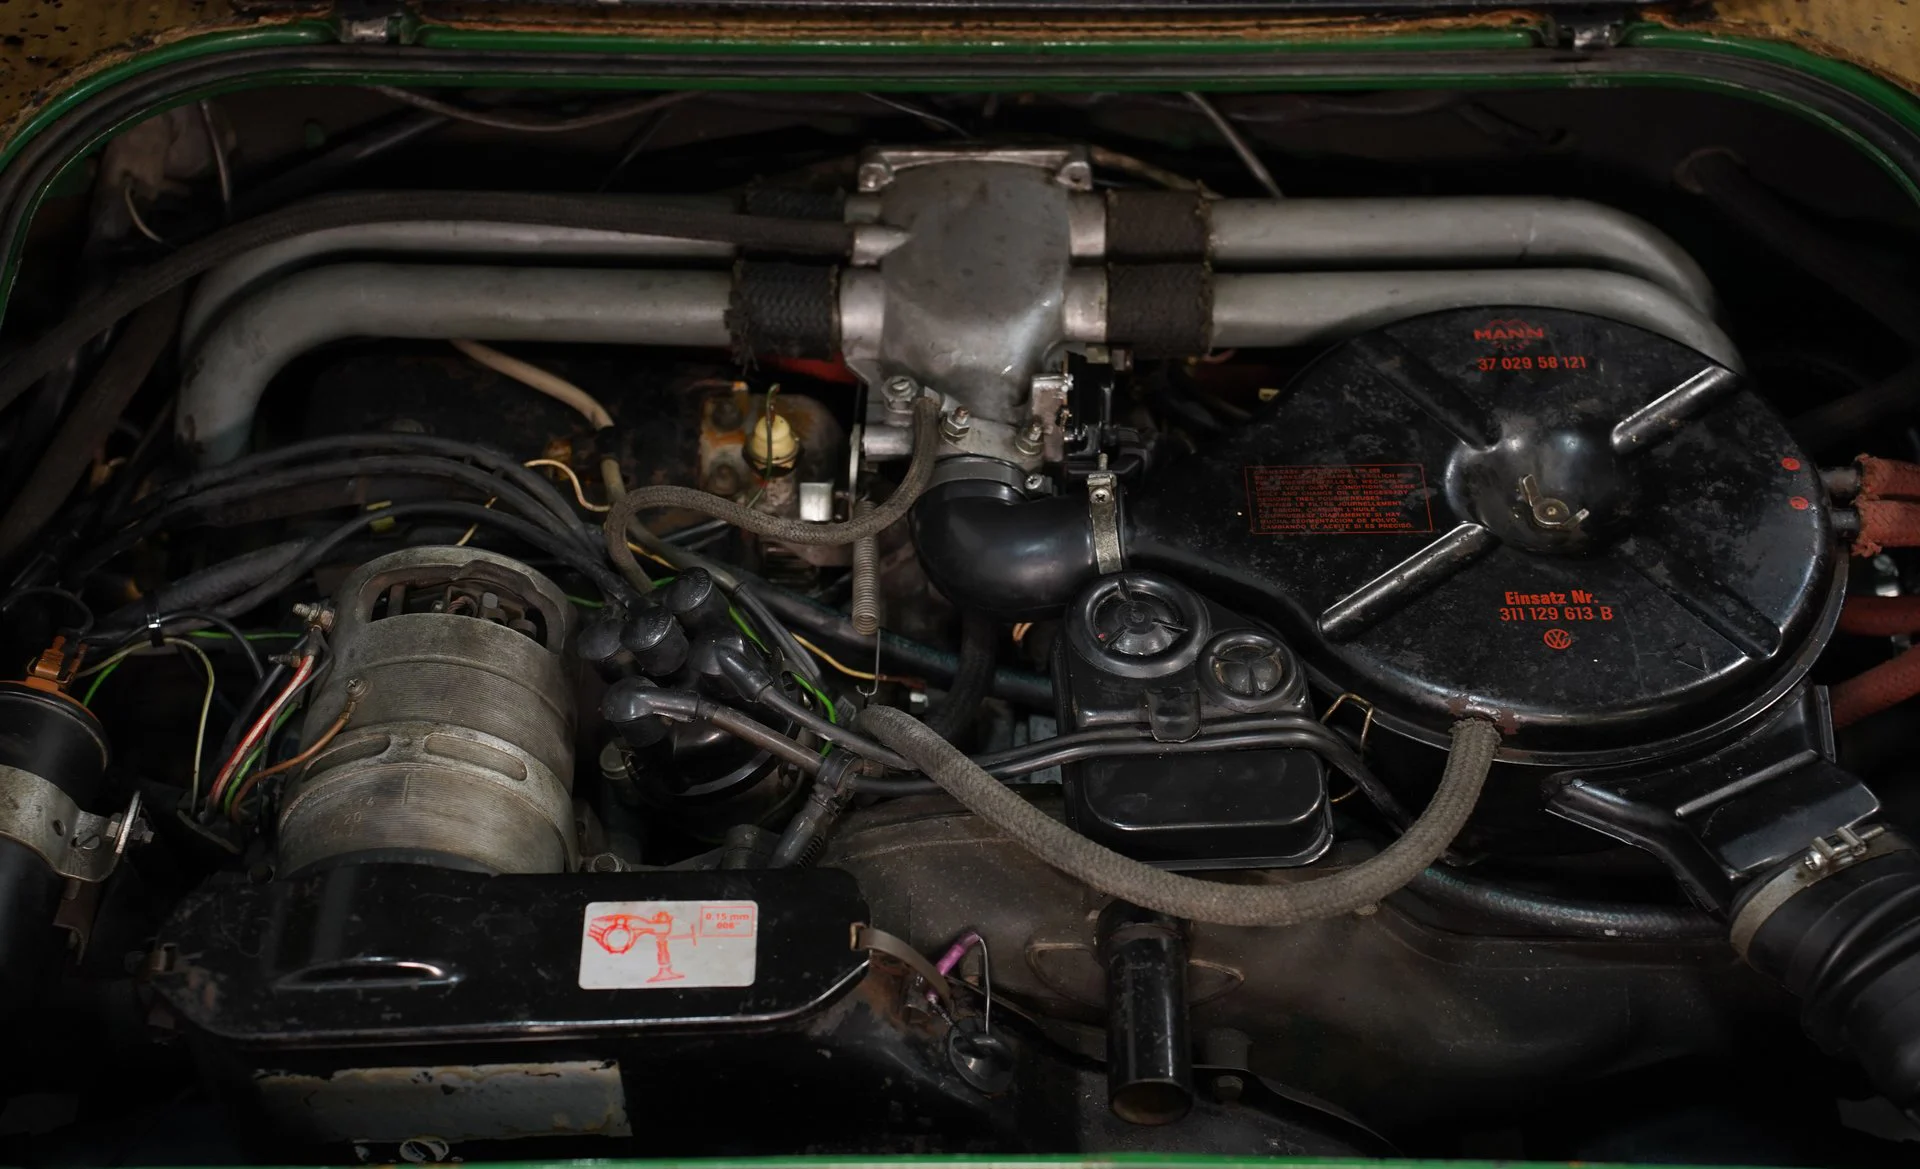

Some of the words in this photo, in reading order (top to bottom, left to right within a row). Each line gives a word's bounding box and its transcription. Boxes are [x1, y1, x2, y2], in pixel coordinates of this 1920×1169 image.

[1474, 328, 1544, 340] MANN
[1478, 357, 1496, 371] 37
[1501, 357, 1532, 370] 029
[1538, 356, 1558, 369] 58
[1563, 356, 1586, 368] 121
[1505, 592, 1567, 605] Einsatz
[1571, 590, 1598, 604] Nr.
[1499, 607, 1525, 621] 311
[1530, 607, 1559, 620] 129
[1564, 606, 1593, 620] 613
[1600, 606, 1613, 620] B
